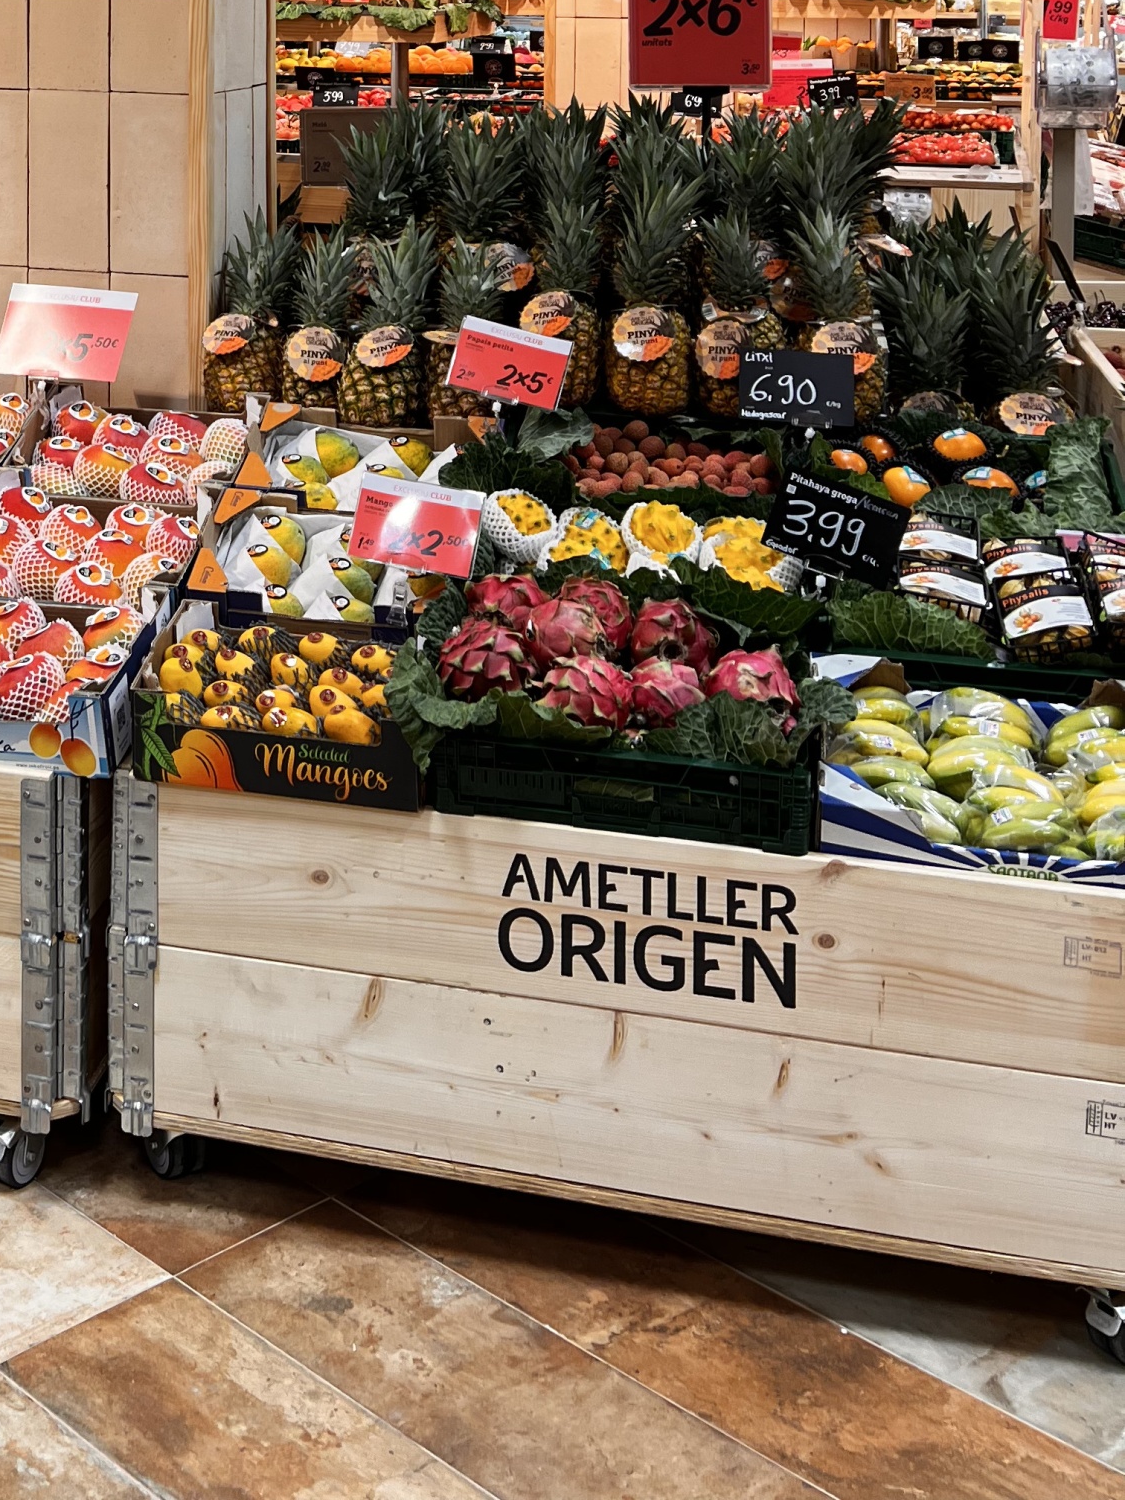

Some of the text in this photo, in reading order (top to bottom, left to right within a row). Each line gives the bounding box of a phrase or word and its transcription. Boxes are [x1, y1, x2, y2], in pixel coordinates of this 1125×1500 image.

[80, 296, 102, 304] CLUB
[532, 310, 562, 321] PINYA
[214, 329, 242, 339] PINYA
[491, 326, 544, 346] EXCLUSIU CLUB
[627, 329, 662, 340] PINYA
[369, 341, 402, 356] PINYA
[467, 334, 491, 347] Papaia
[492, 342, 514, 352] petita
[300, 350, 333, 360] PINYA
[708, 345, 739, 356] PINYA
[827, 346, 862, 355] PINYA
[748, 373, 817, 406] 6,90
[1015, 412, 1053, 423] PINYA
[790, 472, 858, 505] Pitahaya groga
[366, 495, 394, 508] Mango
[430, 492, 452, 502] CLUB
[782, 500, 866, 557] 3,99
[907, 522, 945, 531] hysalis
[985, 544, 1033, 560] Physalis
[901, 565, 951, 575] Physalis
[1002, 588, 1050, 608] Physalis
[298, 743, 351, 764] Selected
[254, 743, 393, 801] Mangoes
[501, 852, 800, 935] AMETLLER
[498, 907, 797, 1009] ORIGEN
[1104, 1111, 1117, 1121] LV
[1104, 1121, 1117, 1131] HT
